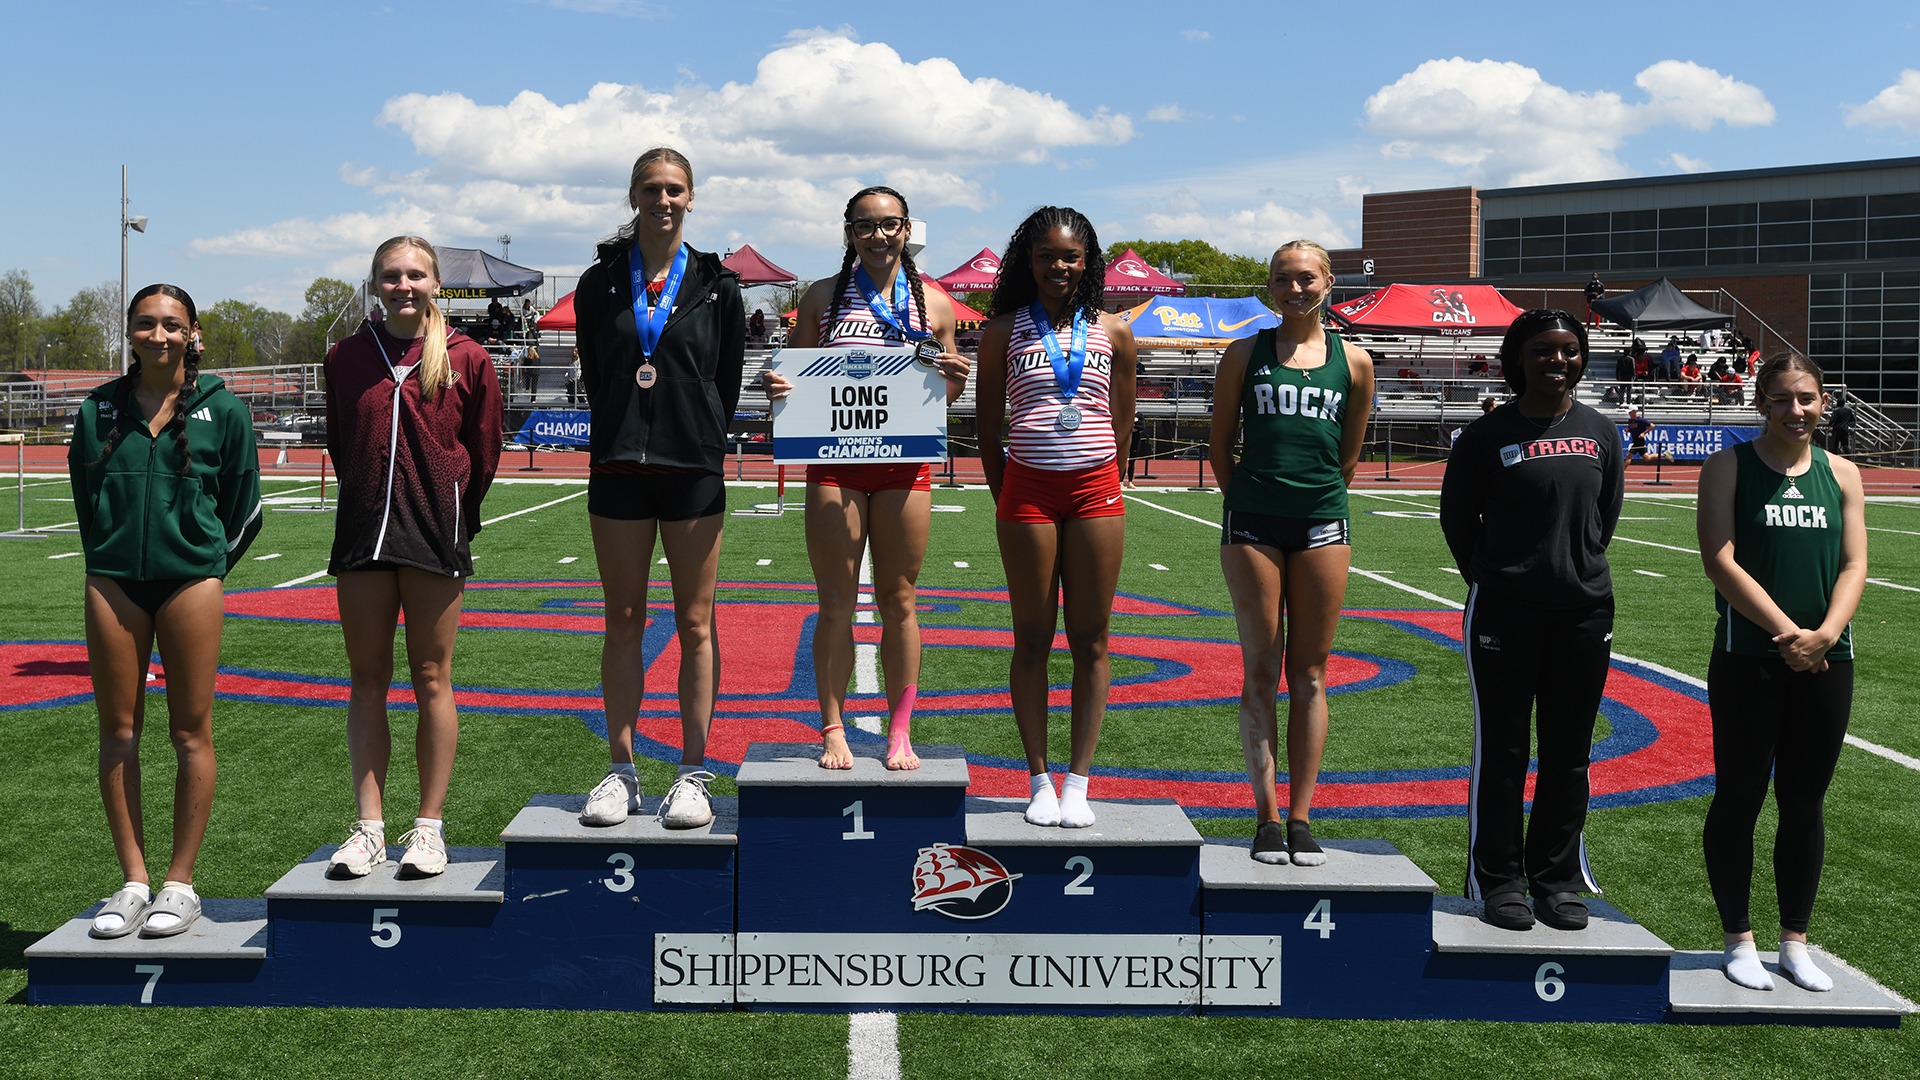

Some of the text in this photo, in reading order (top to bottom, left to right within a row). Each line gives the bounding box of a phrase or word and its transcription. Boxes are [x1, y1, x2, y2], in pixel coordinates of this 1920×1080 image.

[1363, 261, 1374, 274] G
[431, 288, 487, 299] RSVILLE
[1116, 284, 1141, 292] TRACK
[1150, 285, 1172, 293] FIELD
[1152, 305, 1204, 329] Pitt
[1432, 311, 1464, 324] CAL
[829, 321, 919, 345] VULCA
[1179, 339, 1204, 347] CATS
[1440, 328, 1473, 336] VULCANS
[1011, 350, 1112, 378] VULNS
[830, 386, 888, 407] LONG
[1254, 383, 1342, 422] ROCK
[830, 409, 889, 432] JUMP
[838, 436, 883, 446] WOMEN'S
[1676, 429, 1723, 442] STATE
[817, 444, 903, 459] CHAMPION
[1523, 439, 1597, 457] TRACK
[1764, 504, 1828, 529] ROCK
[842, 800, 875, 841] 1
[603, 852, 635, 893] 3
[1063, 855, 1095, 896] 2
[370, 908, 402, 949] 5
[1303, 899, 1336, 939] 4
[659, 947, 1275, 990] SHIPPENSBURG UNIVERSITY
[135, 964, 164, 1004] 7
[1534, 961, 1566, 1002] 6
